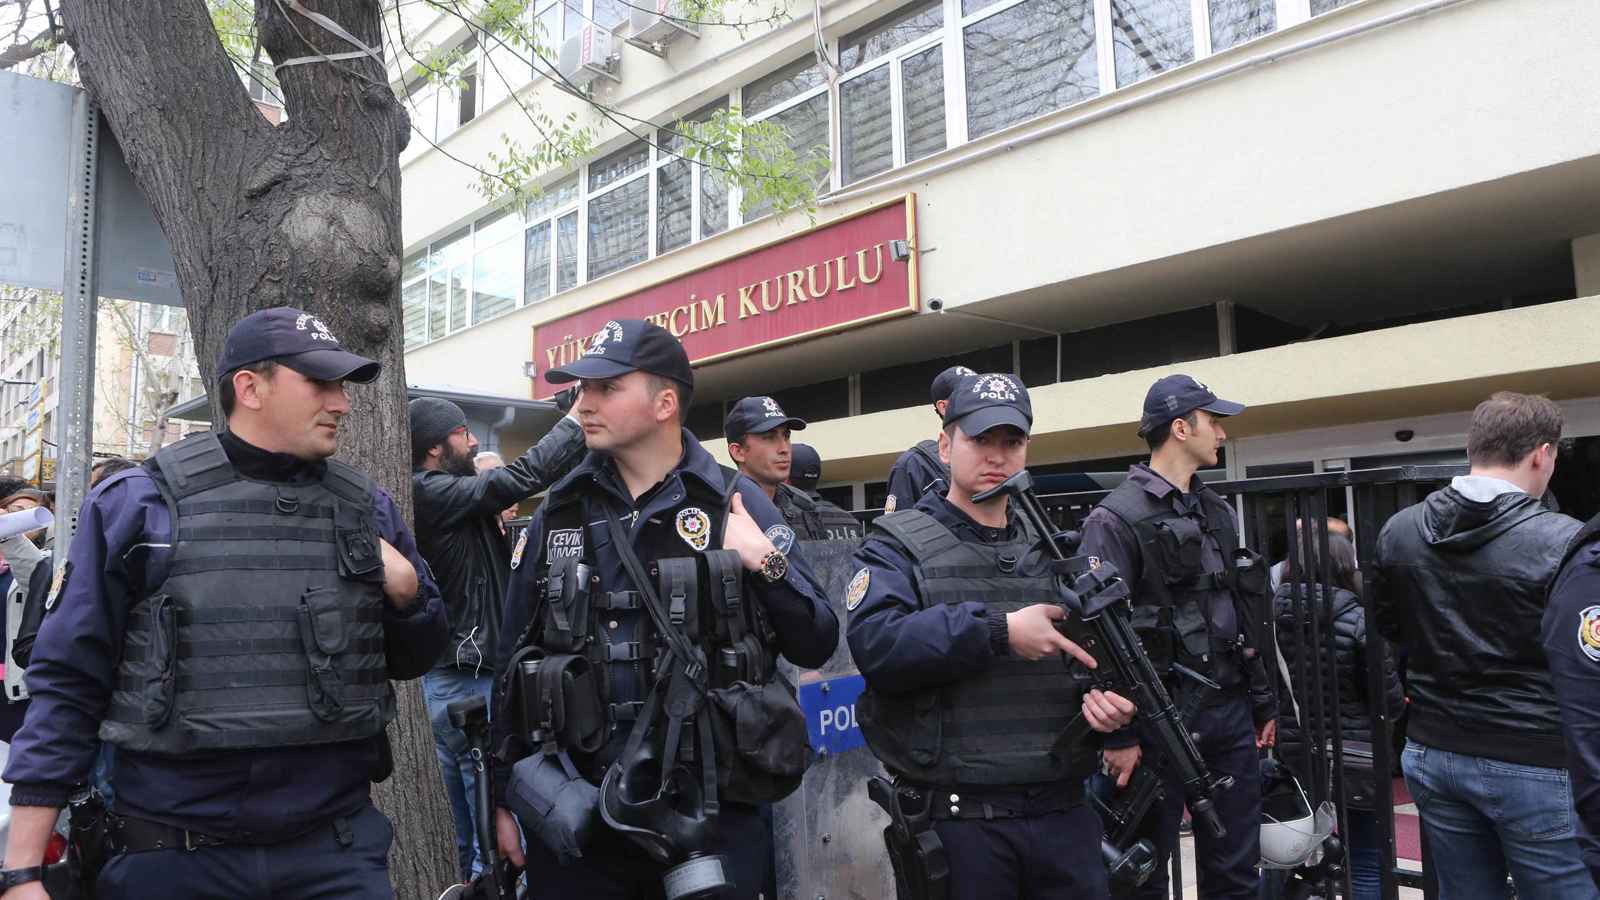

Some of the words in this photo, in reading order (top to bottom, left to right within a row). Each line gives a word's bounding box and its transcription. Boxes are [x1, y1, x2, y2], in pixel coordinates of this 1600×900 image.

[645, 293, 727, 343] EÇİM
[738, 244, 885, 320] KURULU
[820, 704, 859, 736] POL
